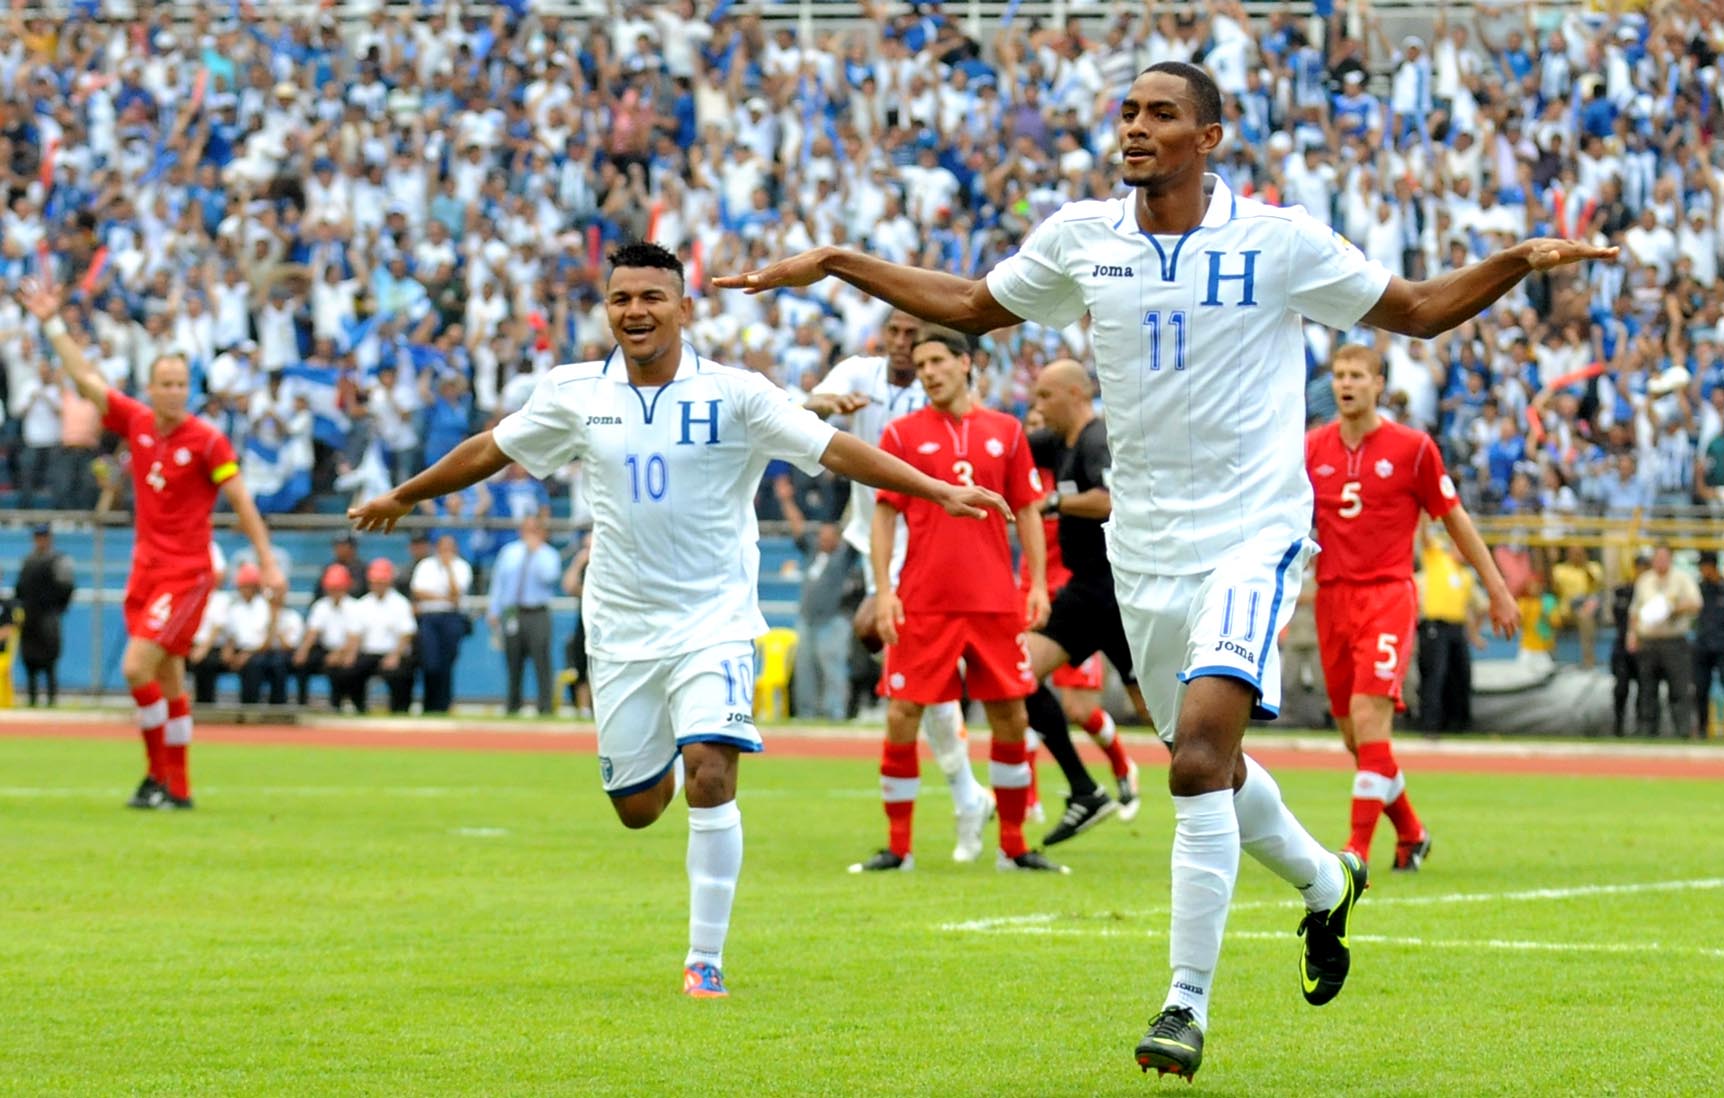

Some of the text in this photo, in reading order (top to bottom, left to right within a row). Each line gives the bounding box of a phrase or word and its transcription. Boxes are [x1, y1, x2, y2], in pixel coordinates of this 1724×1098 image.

[1200, 250, 1262, 306] H
[1143, 311, 1186, 371] 11
[675, 399, 723, 445] H
[146, 461, 166, 492] 4
[625, 452, 669, 503] 10
[1338, 482, 1363, 519] 5
[150, 592, 172, 623] 4
[1374, 633, 1399, 671] 5
